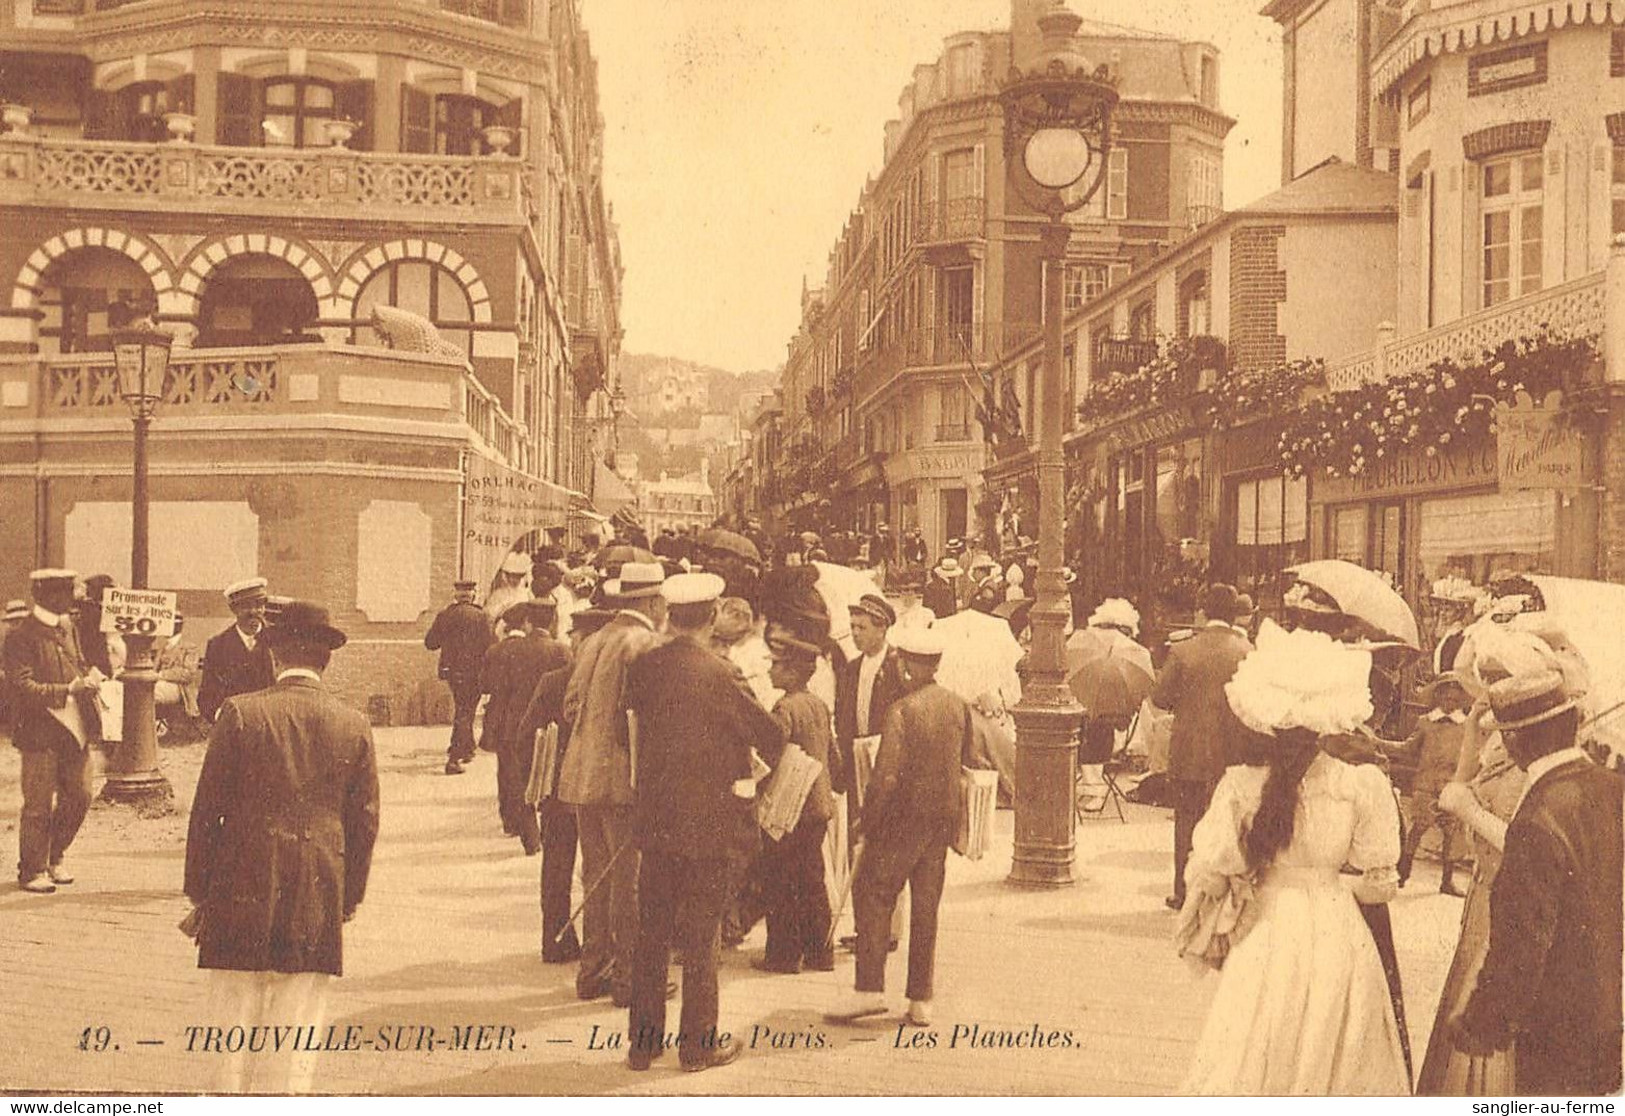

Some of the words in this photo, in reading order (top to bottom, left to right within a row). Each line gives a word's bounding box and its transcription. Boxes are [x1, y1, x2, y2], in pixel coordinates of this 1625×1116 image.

[471, 476, 538, 493] ORLHAC
[466, 529, 511, 547] PARIS
[111, 590, 167, 606] Promenade
[105, 604, 122, 615] sur
[126, 605, 140, 616] les
